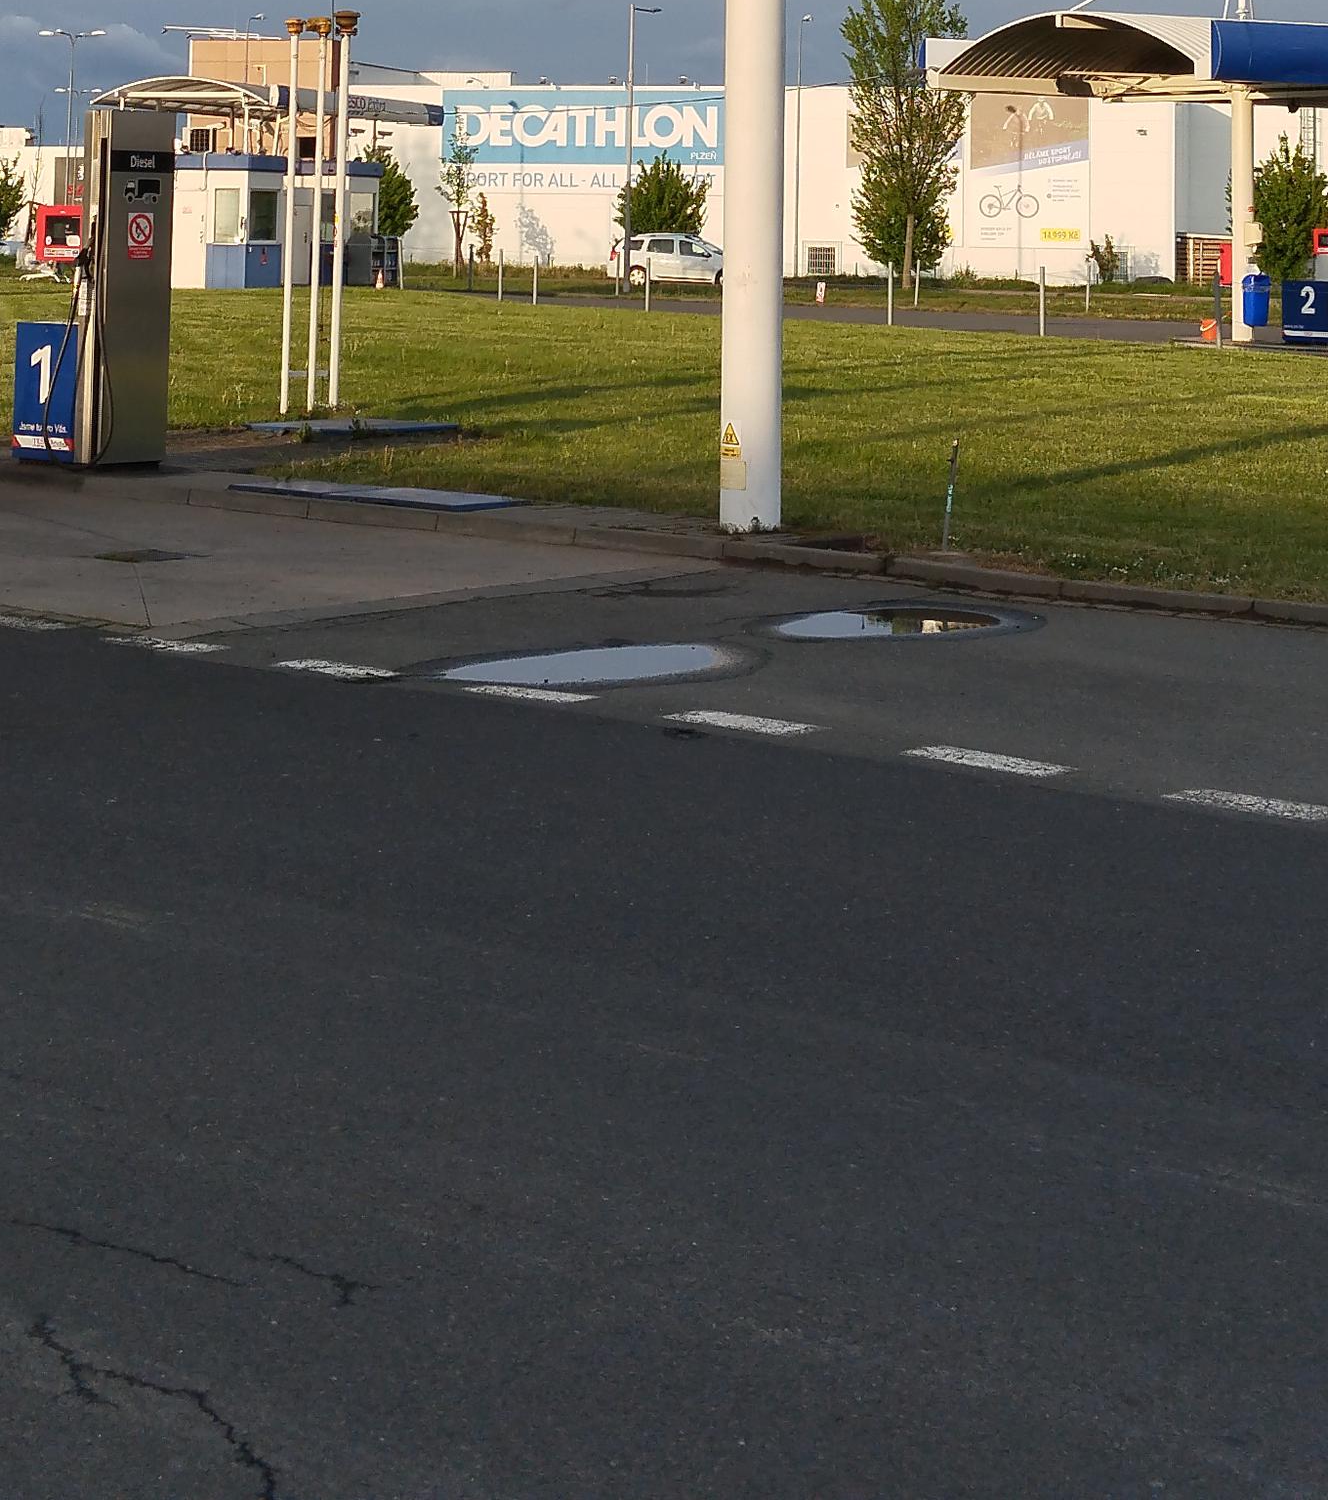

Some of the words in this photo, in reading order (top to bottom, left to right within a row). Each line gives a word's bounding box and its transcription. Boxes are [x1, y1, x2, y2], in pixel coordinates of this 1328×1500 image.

[455, 104, 718, 149] DECATHLON
[130, 154, 156, 169] Diesel
[690, 150, 717, 161] PLZEŇ
[464, 172, 508, 188] PORT
[513, 172, 544, 188] FOR
[549, 172, 580, 188] ALL
[590, 172, 620, 189] ALL
[1300, 285, 1316, 314] 2
[30, 344, 52, 405] 1
